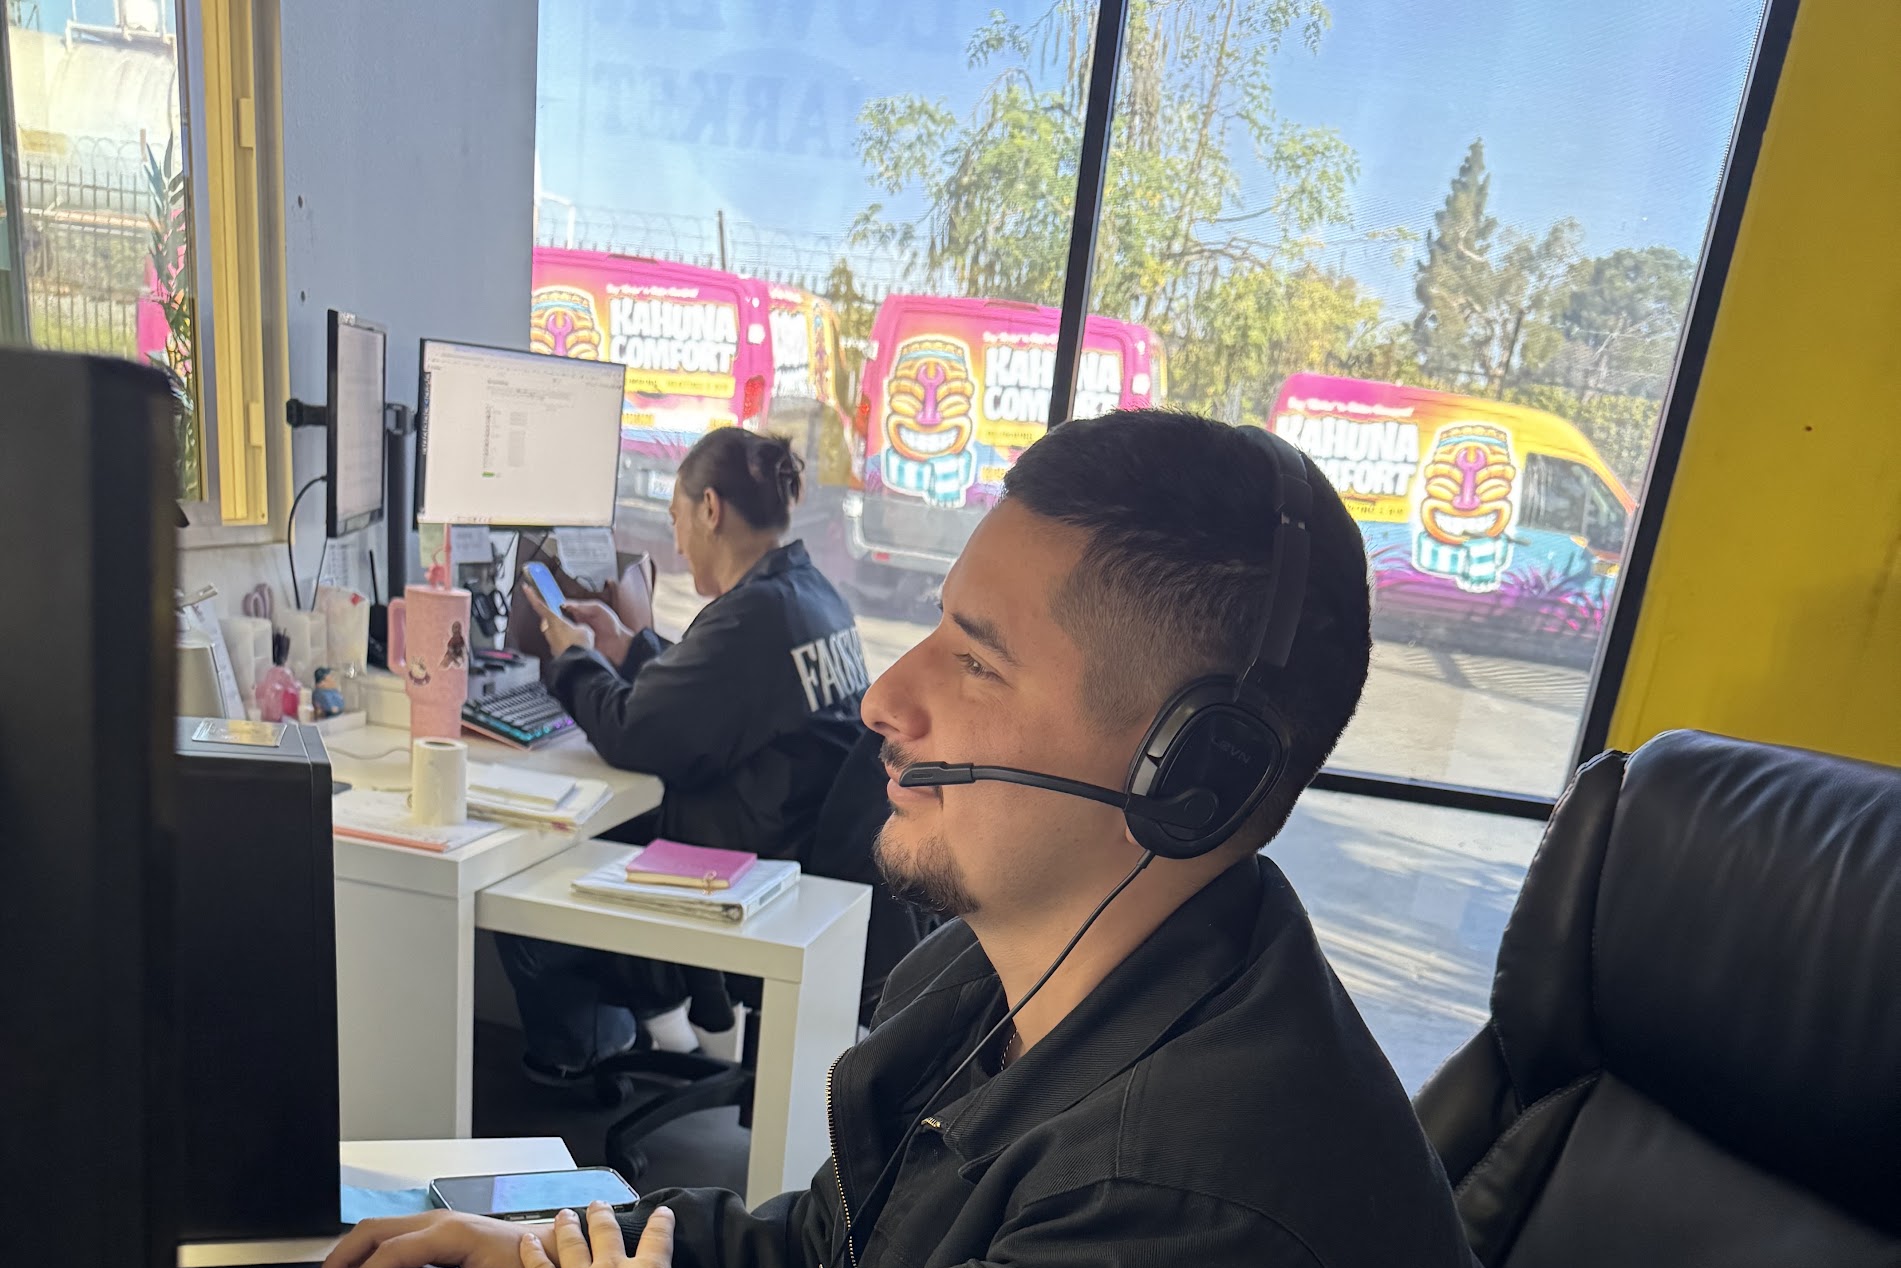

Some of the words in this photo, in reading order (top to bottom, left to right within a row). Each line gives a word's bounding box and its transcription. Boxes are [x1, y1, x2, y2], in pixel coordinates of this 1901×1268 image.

[610, 298, 737, 343] KAHUNA
[610, 336, 736, 373] COMFORT
[984, 345, 1121, 393] KAHNA
